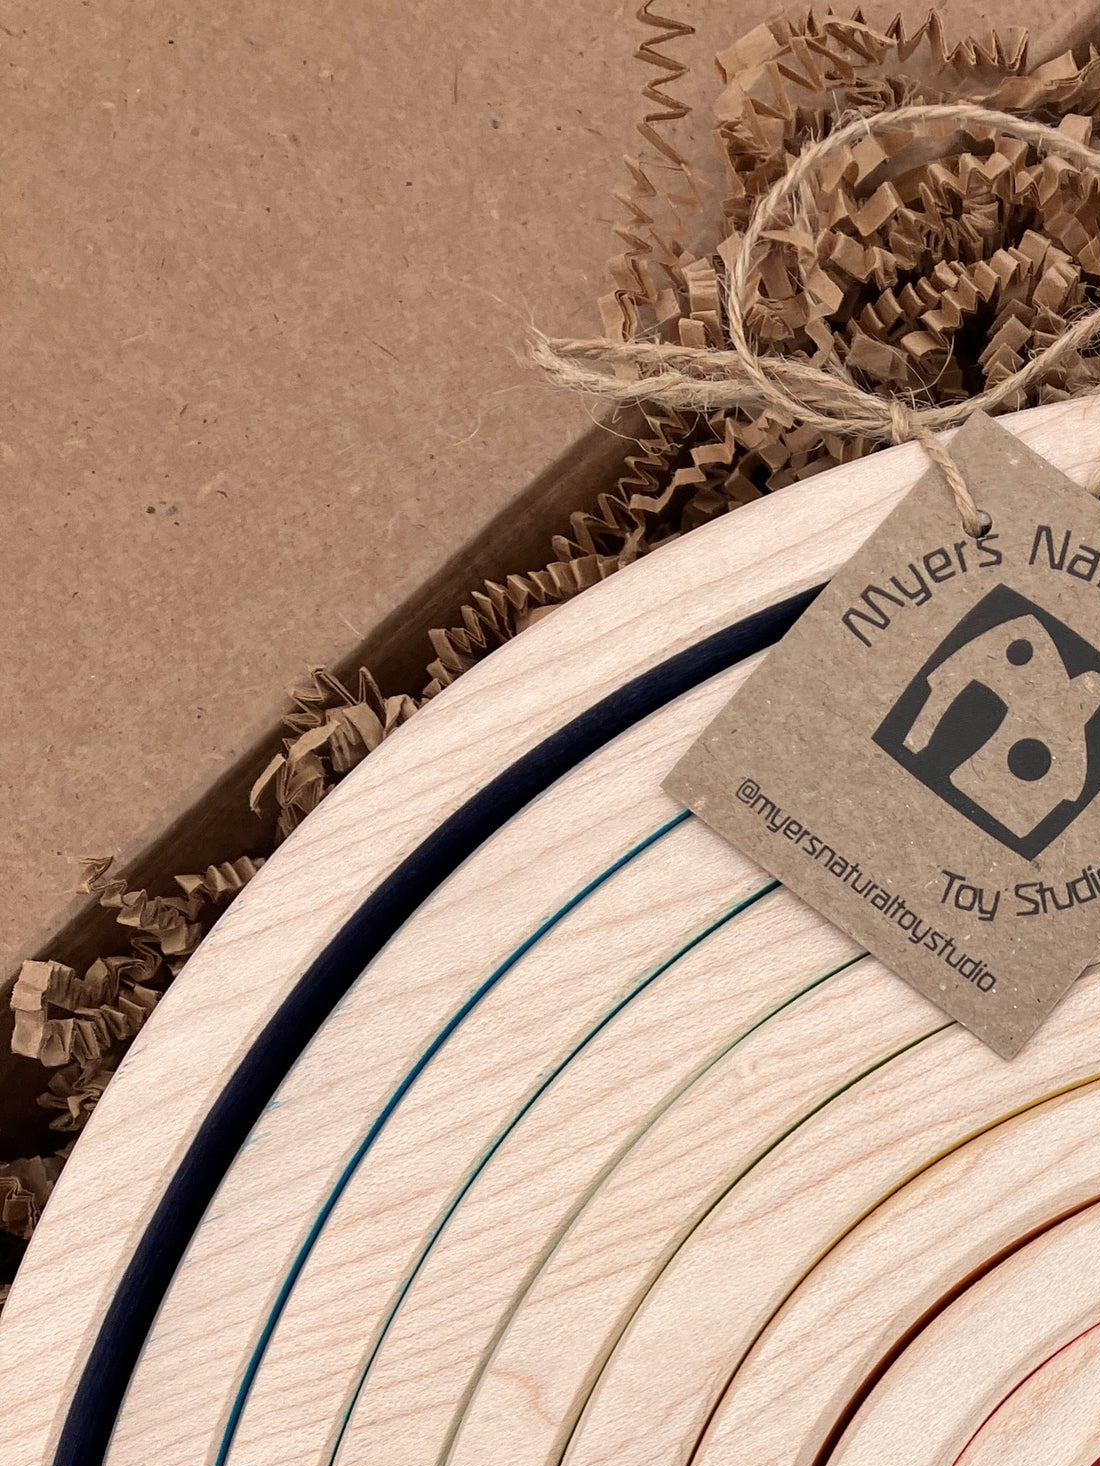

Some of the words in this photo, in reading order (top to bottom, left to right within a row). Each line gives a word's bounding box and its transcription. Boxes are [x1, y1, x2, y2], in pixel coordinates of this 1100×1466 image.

[842, 533, 1003, 648] Myers
[735, 777, 998, 993] @myersnaturaltoystudio
[941, 868, 1001, 922] Toy
